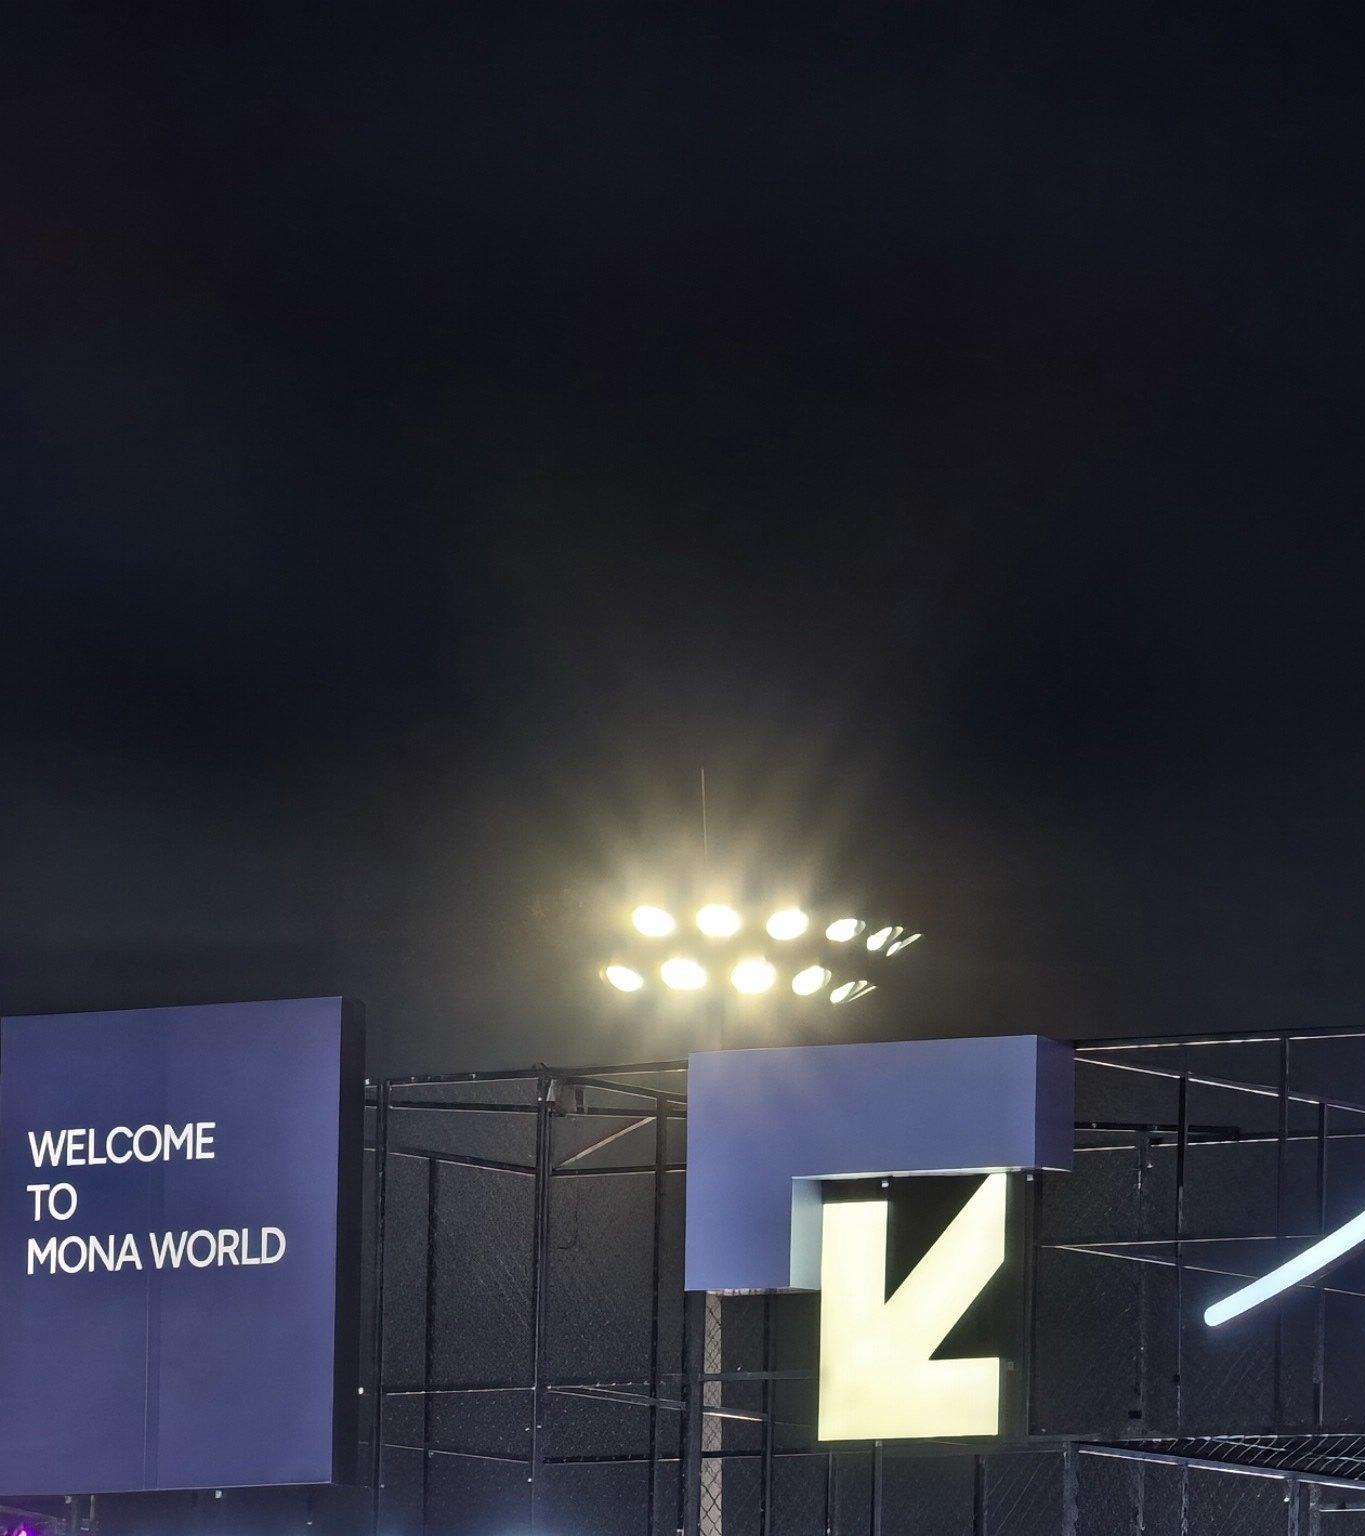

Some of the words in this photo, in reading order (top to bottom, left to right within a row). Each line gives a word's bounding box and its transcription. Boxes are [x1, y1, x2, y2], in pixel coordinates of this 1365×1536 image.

[27, 1121, 216, 1168] WELCOME
[26, 1182, 78, 1222] TO
[26, 1233, 143, 1275] MONA
[149, 1226, 287, 1270] WORLD
